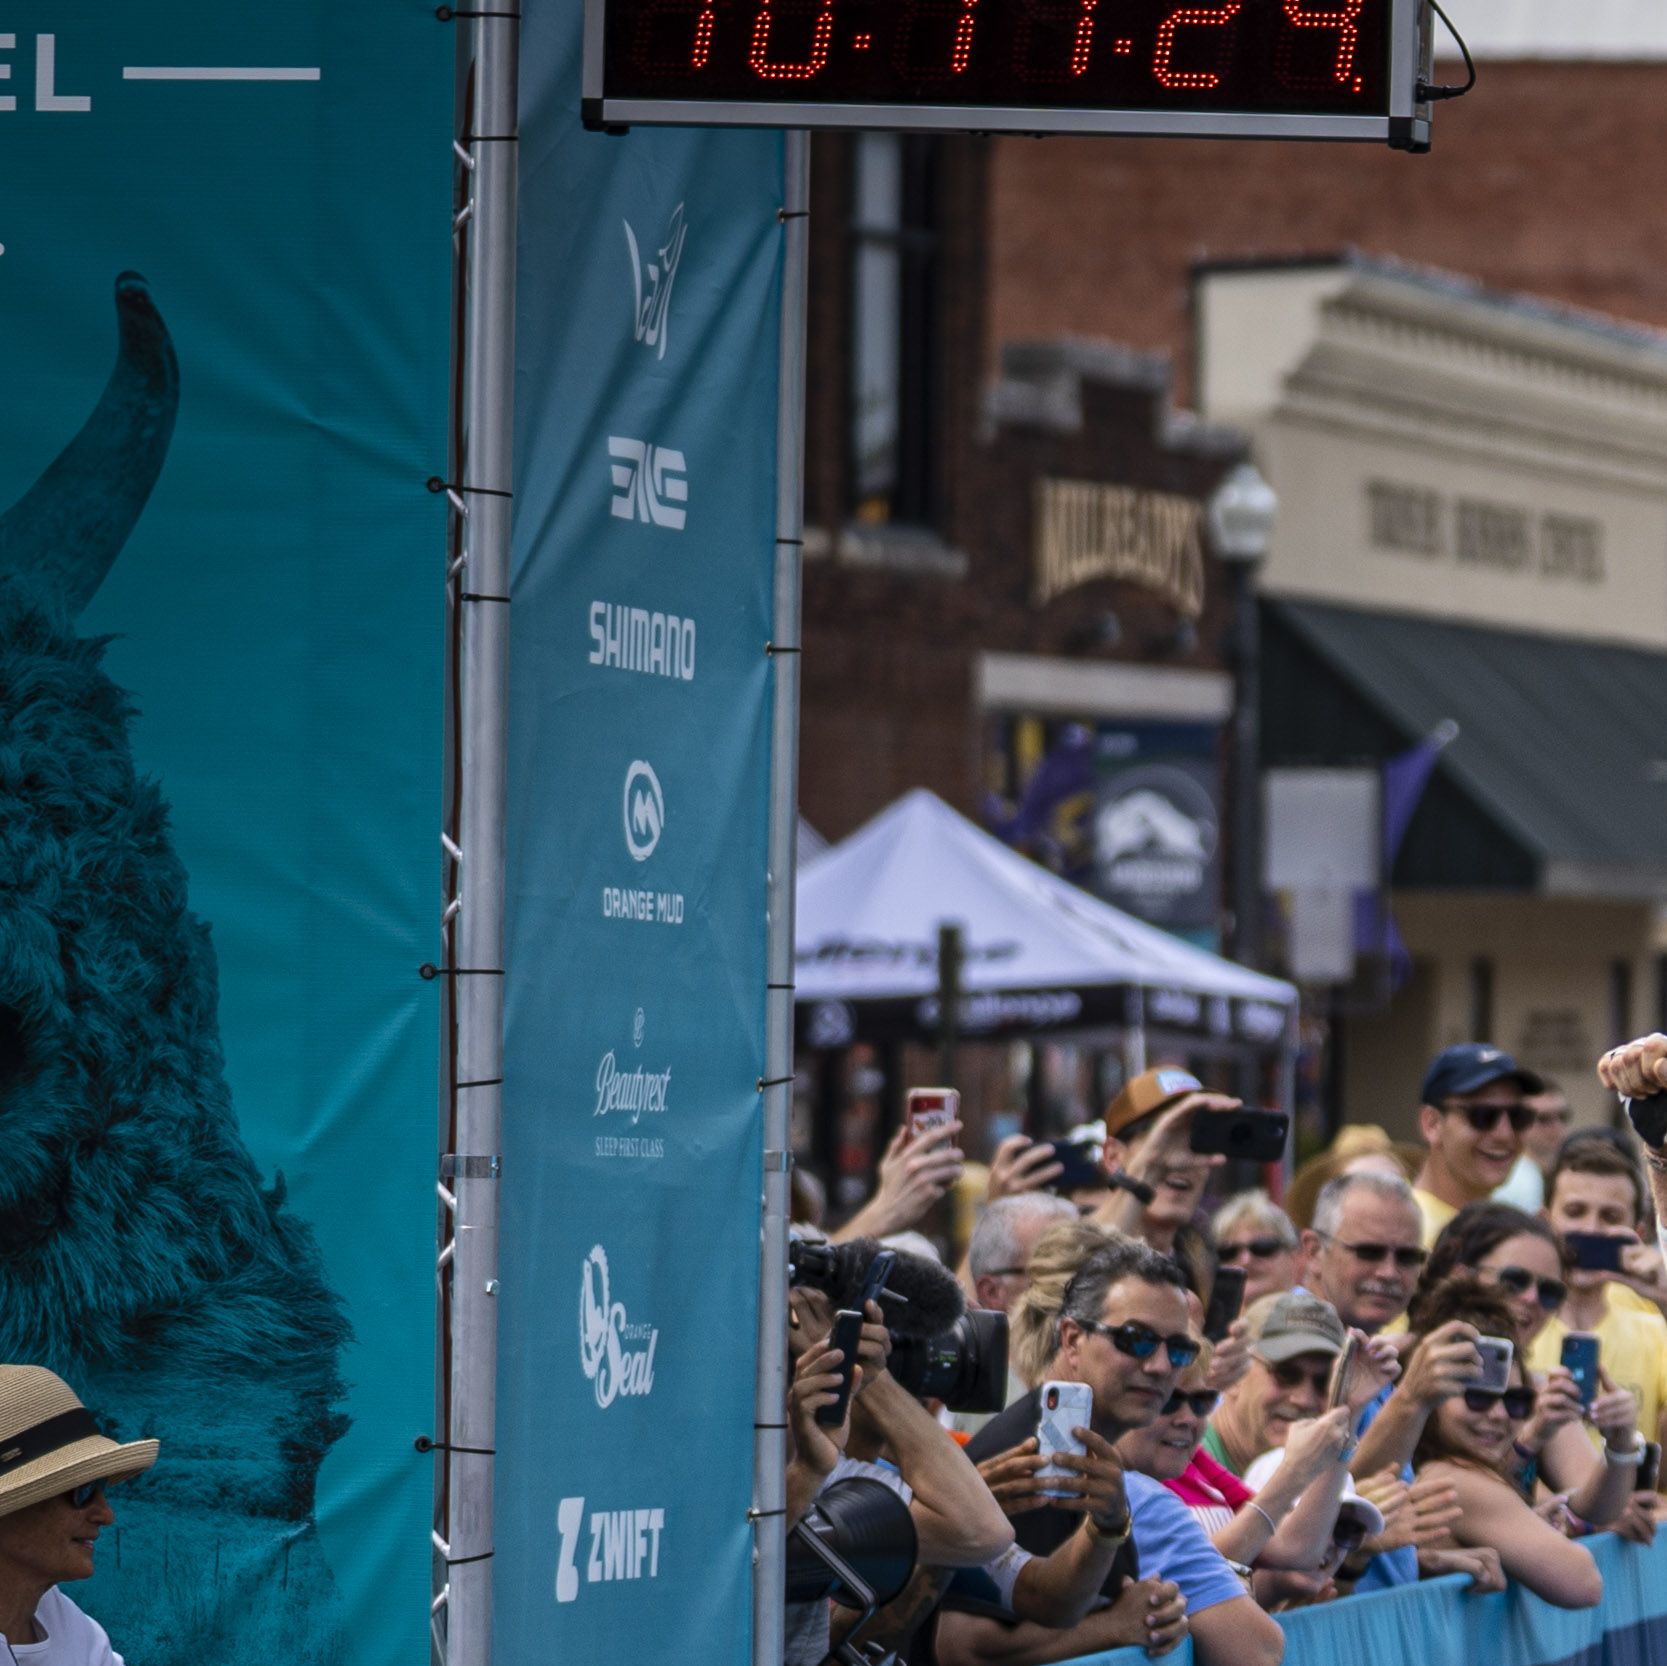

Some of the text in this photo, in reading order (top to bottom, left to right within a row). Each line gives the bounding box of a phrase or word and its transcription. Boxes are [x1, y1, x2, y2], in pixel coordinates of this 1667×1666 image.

[589, 600, 697, 682] SHIMANO
[603, 887, 684, 925] ORANGE MUD
[593, 1048, 671, 1125] Beautyrest
[595, 1137, 665, 1159] SLEEP FIRST CLASS
[596, 1302, 660, 1409] Seal
[586, 1507, 665, 1583] ZWIFT
